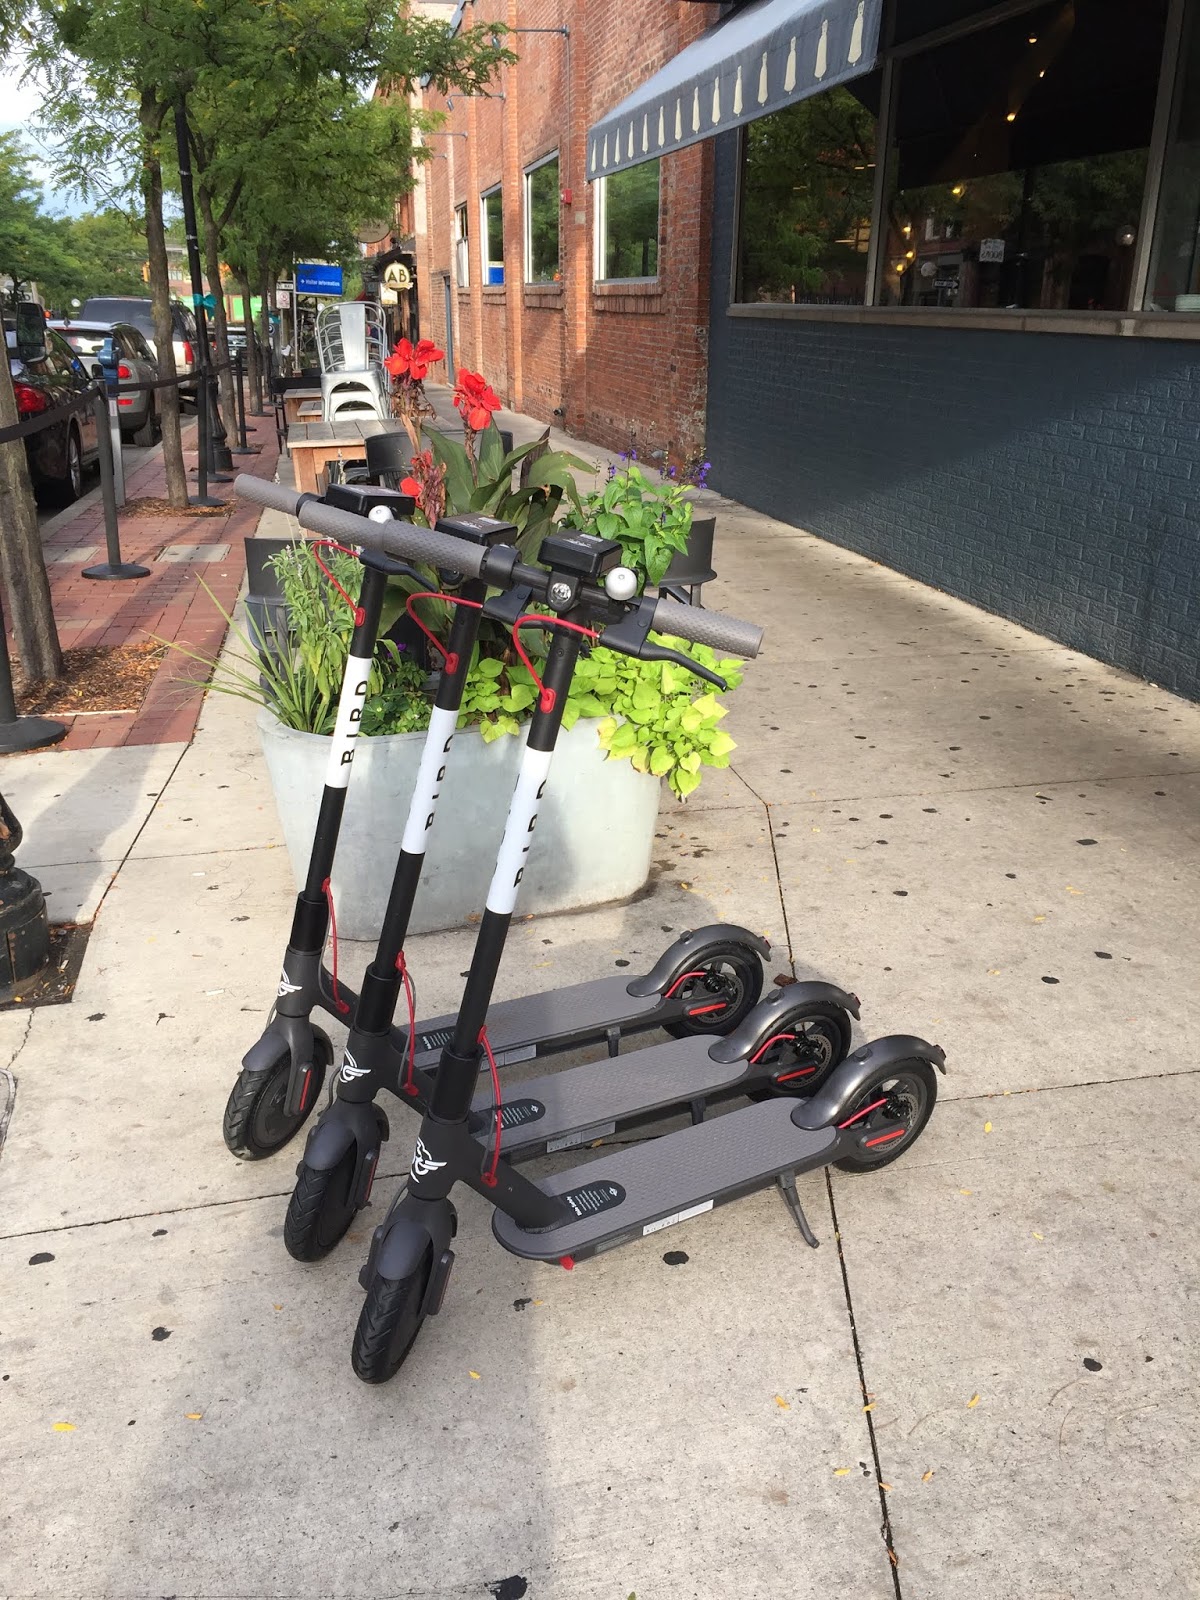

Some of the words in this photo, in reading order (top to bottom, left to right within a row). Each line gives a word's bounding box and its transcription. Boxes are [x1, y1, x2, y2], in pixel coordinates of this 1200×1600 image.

[318, 279, 340, 287] Information
[387, 269, 407, 283] AB
[341, 680, 368, 766] BIRD
